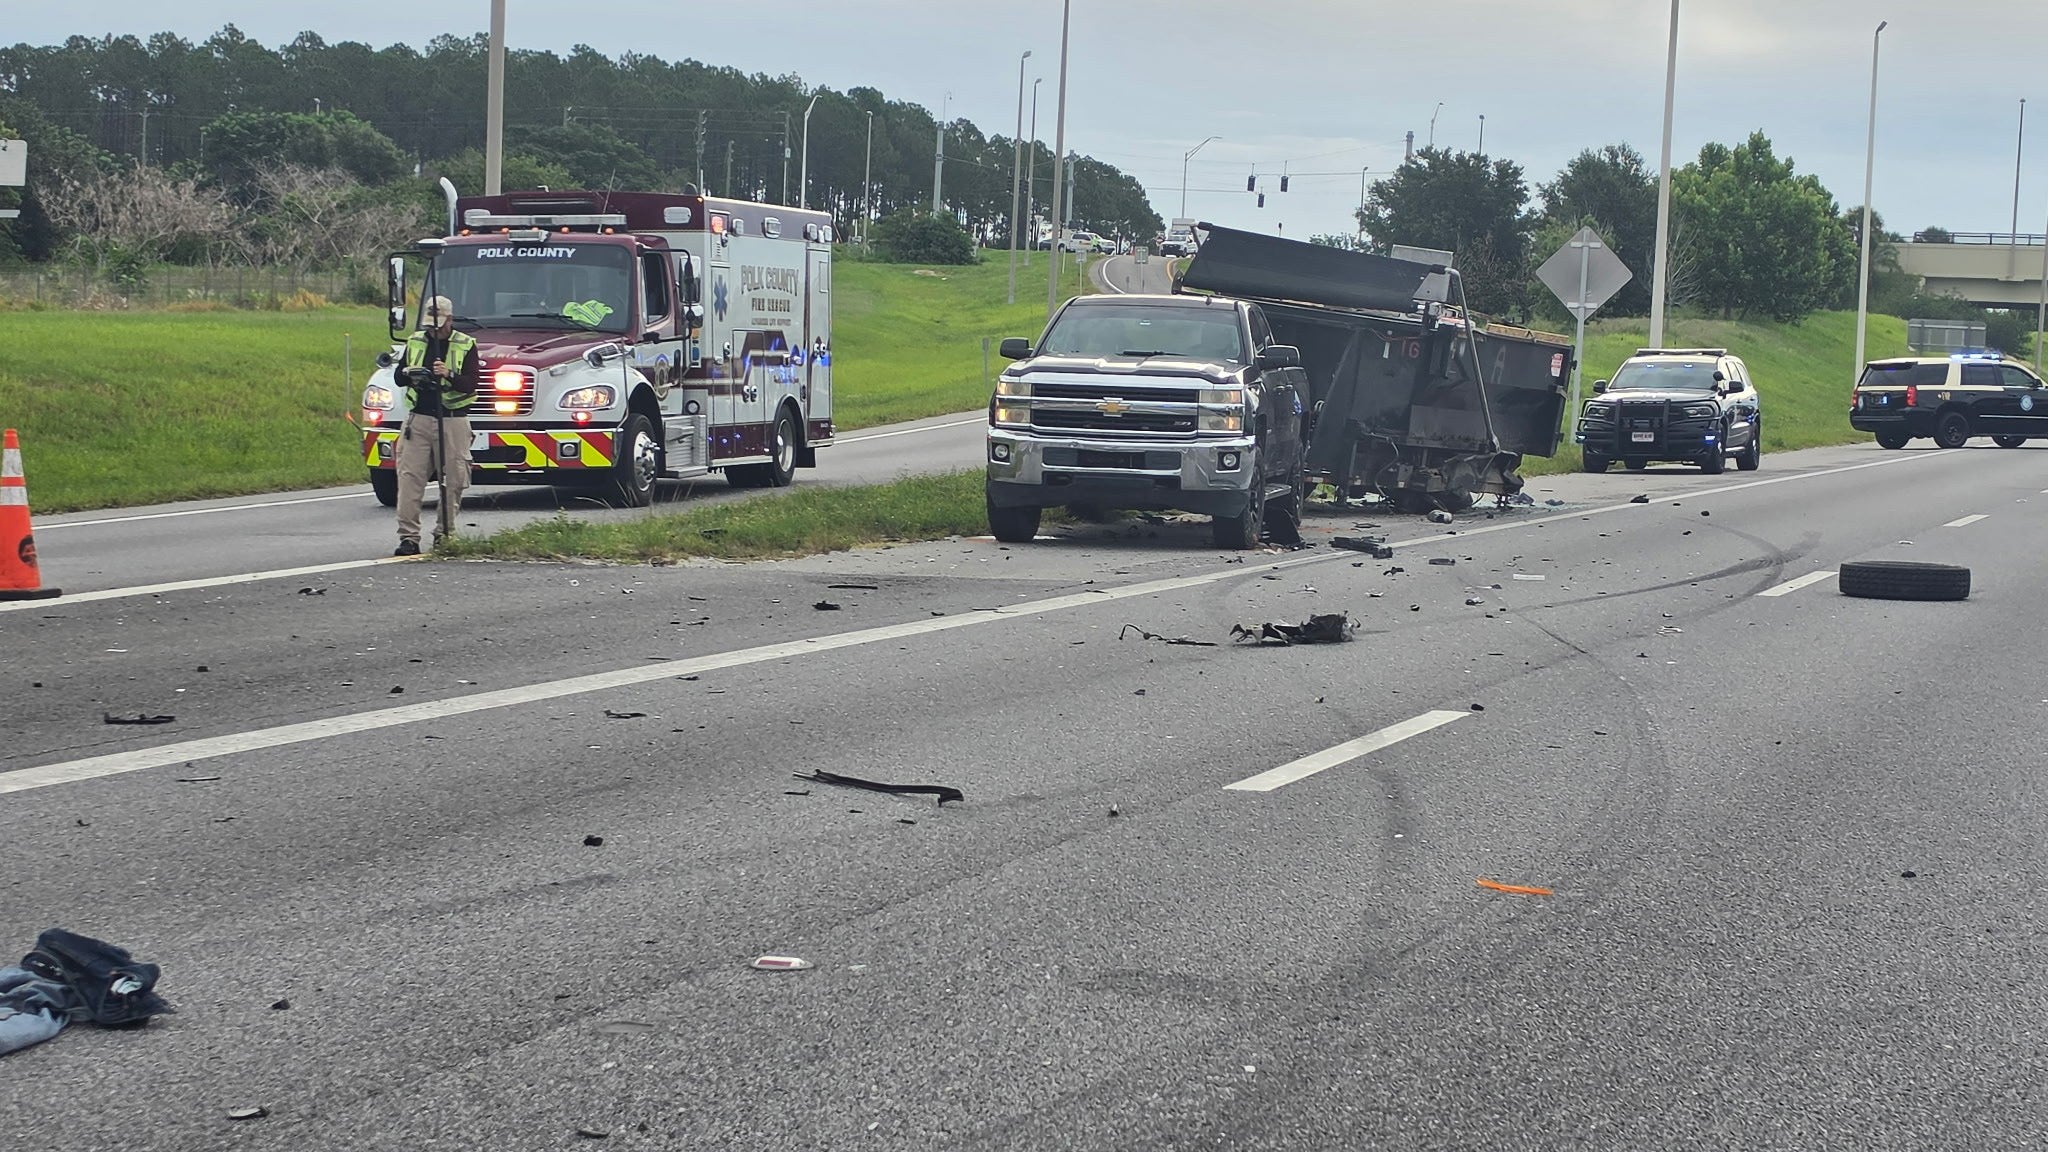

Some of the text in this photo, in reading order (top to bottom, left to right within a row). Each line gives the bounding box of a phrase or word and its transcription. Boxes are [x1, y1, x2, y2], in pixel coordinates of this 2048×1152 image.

[477, 247, 576, 258] POLK COUNTY
[741, 265, 799, 296] POLK COUNTY
